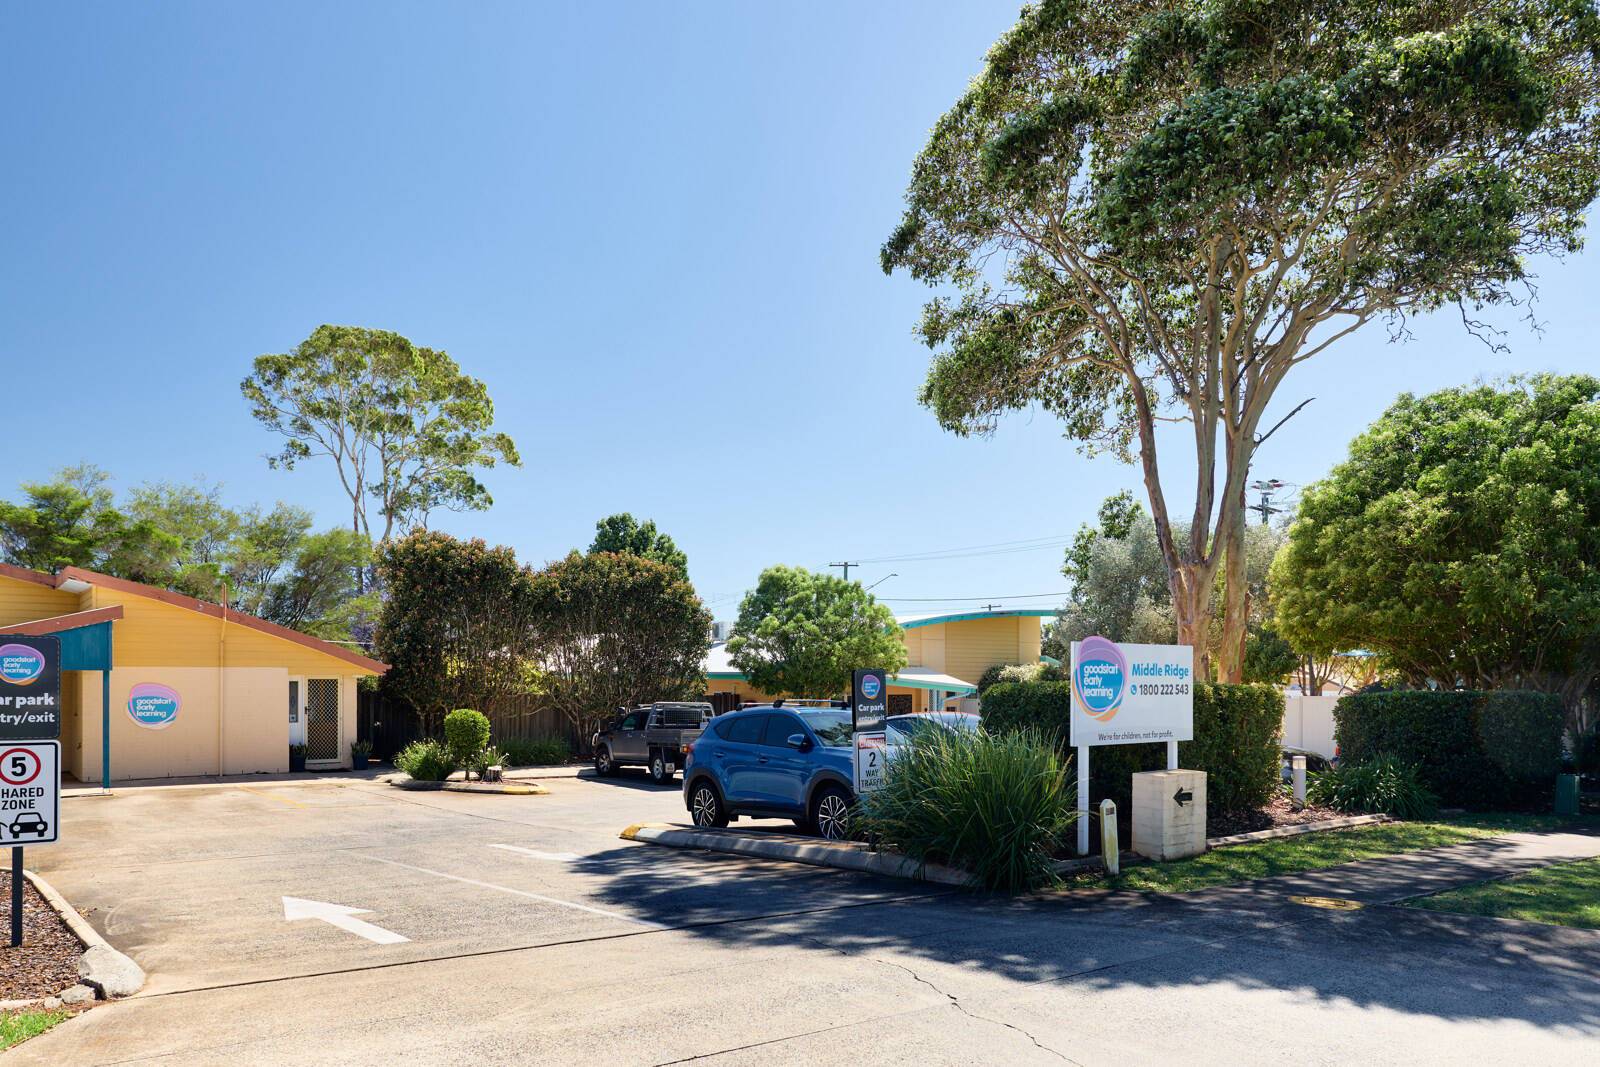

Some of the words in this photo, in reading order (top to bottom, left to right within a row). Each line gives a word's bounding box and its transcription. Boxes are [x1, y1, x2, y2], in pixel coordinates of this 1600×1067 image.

[3, 656, 36, 665] goodstart
[1084, 663, 1118, 676] goodstart
[1132, 663, 1163, 676] Middle
[1165, 664, 1189, 679] Ridge
[1084, 675, 1103, 687] early
[1084, 687, 1113, 699] learning
[1139, 684, 1159, 695] 1800
[1160, 684, 1174, 695] 222
[1175, 684, 1189, 695] 543
[16, 693, 55, 708] park
[136, 698, 171, 706] goodstart
[870, 703, 884, 713] park
[0, 712, 55, 725] try/exit
[1113, 732, 1121, 740] for
[1143, 731, 1151, 739] not
[869, 752, 876, 767] 2
[11, 757, 26, 776] 5
[865, 769, 879, 777] WAY
[2, 787, 44, 798] HARED
[2, 799, 36, 810] ZONE
